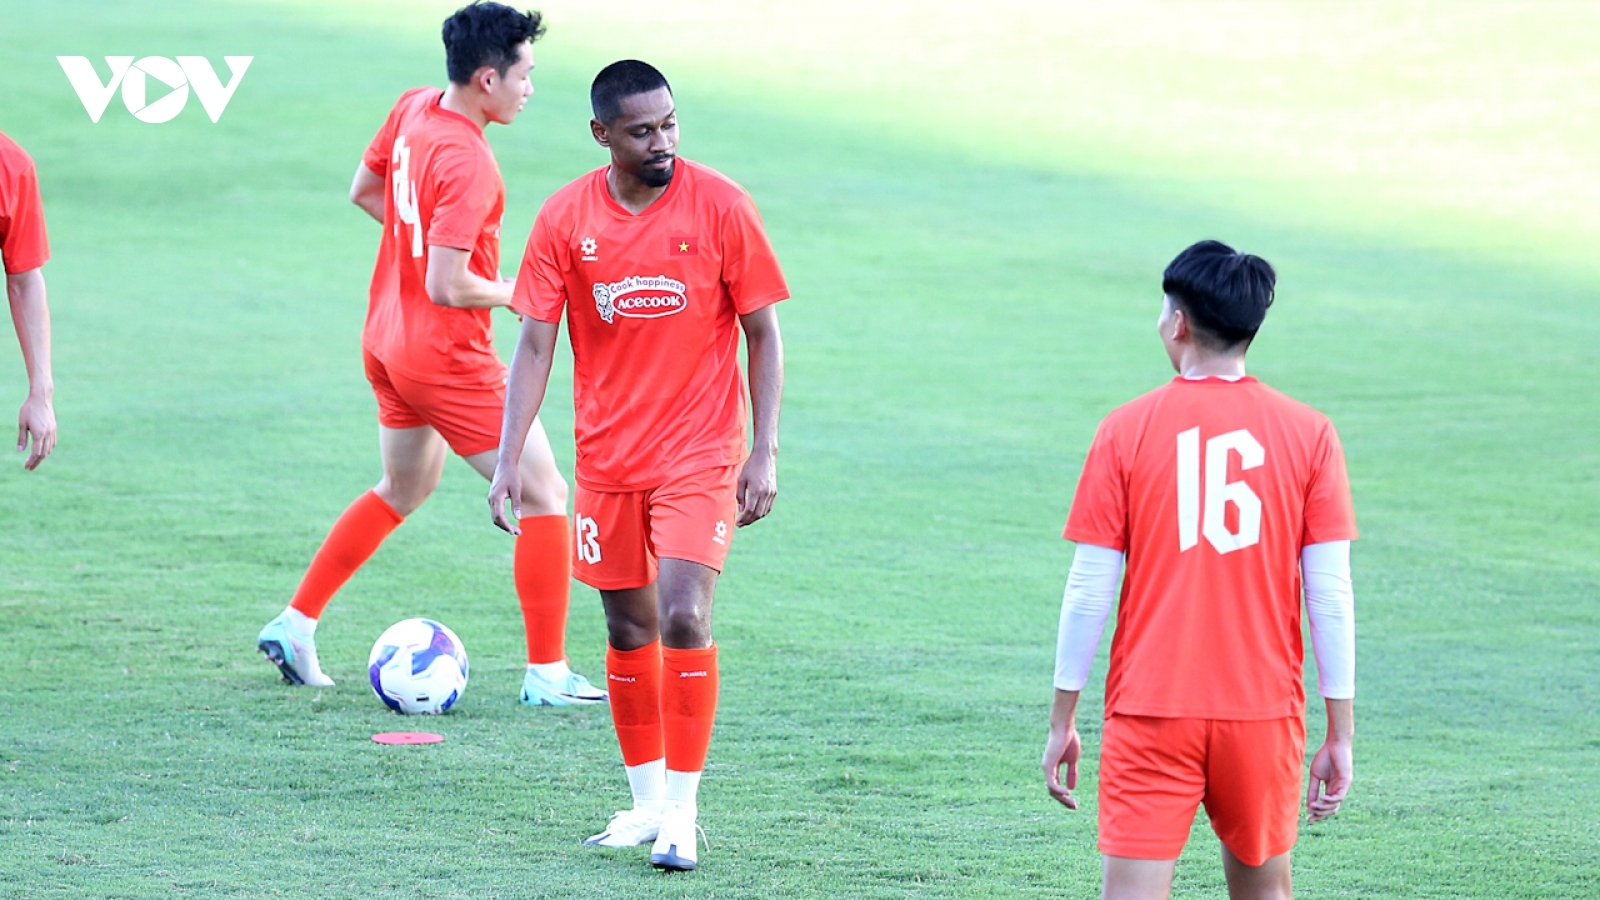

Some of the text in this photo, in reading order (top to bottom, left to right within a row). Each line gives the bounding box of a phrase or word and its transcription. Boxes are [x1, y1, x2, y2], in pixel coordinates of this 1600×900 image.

[610, 277, 684, 294] Cook happiness
[1176, 425, 1266, 556] 16
[575, 513, 602, 565] 13
